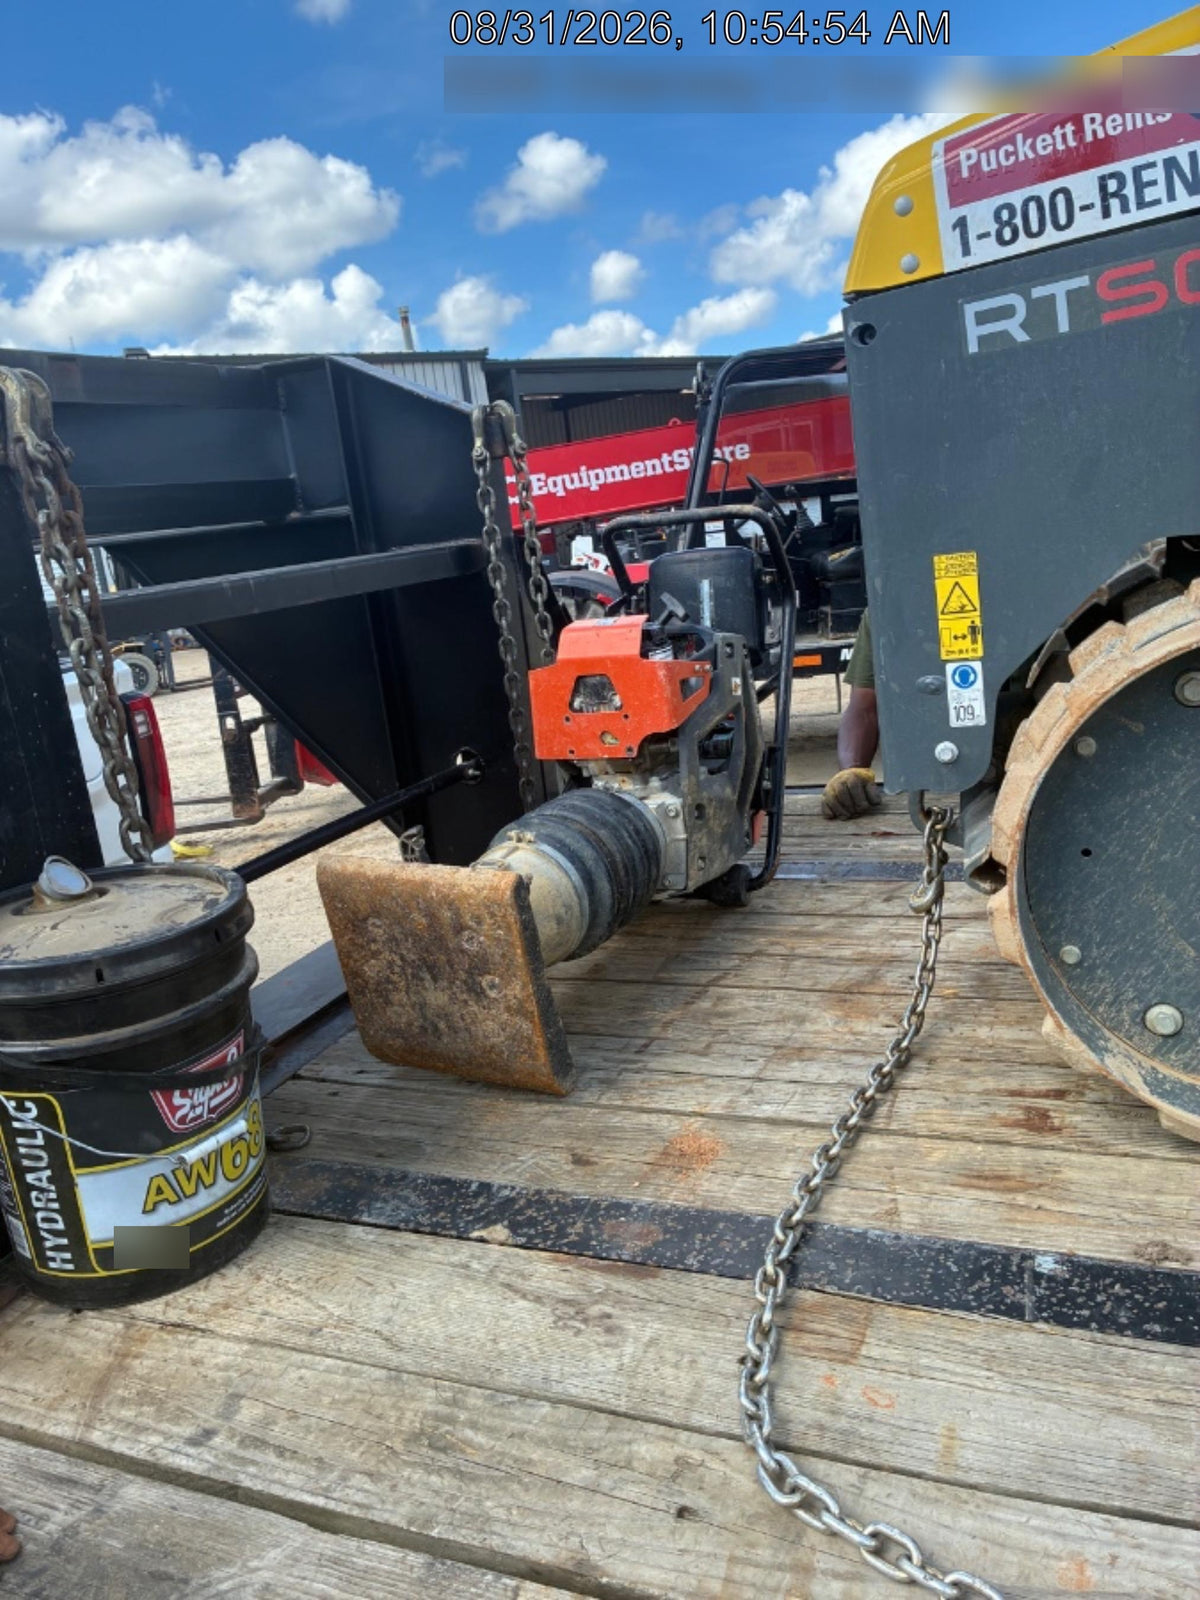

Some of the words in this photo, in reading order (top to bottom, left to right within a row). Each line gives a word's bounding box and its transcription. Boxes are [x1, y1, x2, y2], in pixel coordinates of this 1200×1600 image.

[959, 124, 1077, 178] Puckett
[529, 443, 751, 497] EquipmentSare
[953, 704, 975, 722] 109
[142, 1098, 264, 1215] AW68
[10, 1099, 75, 1271] HYDRAULIC
